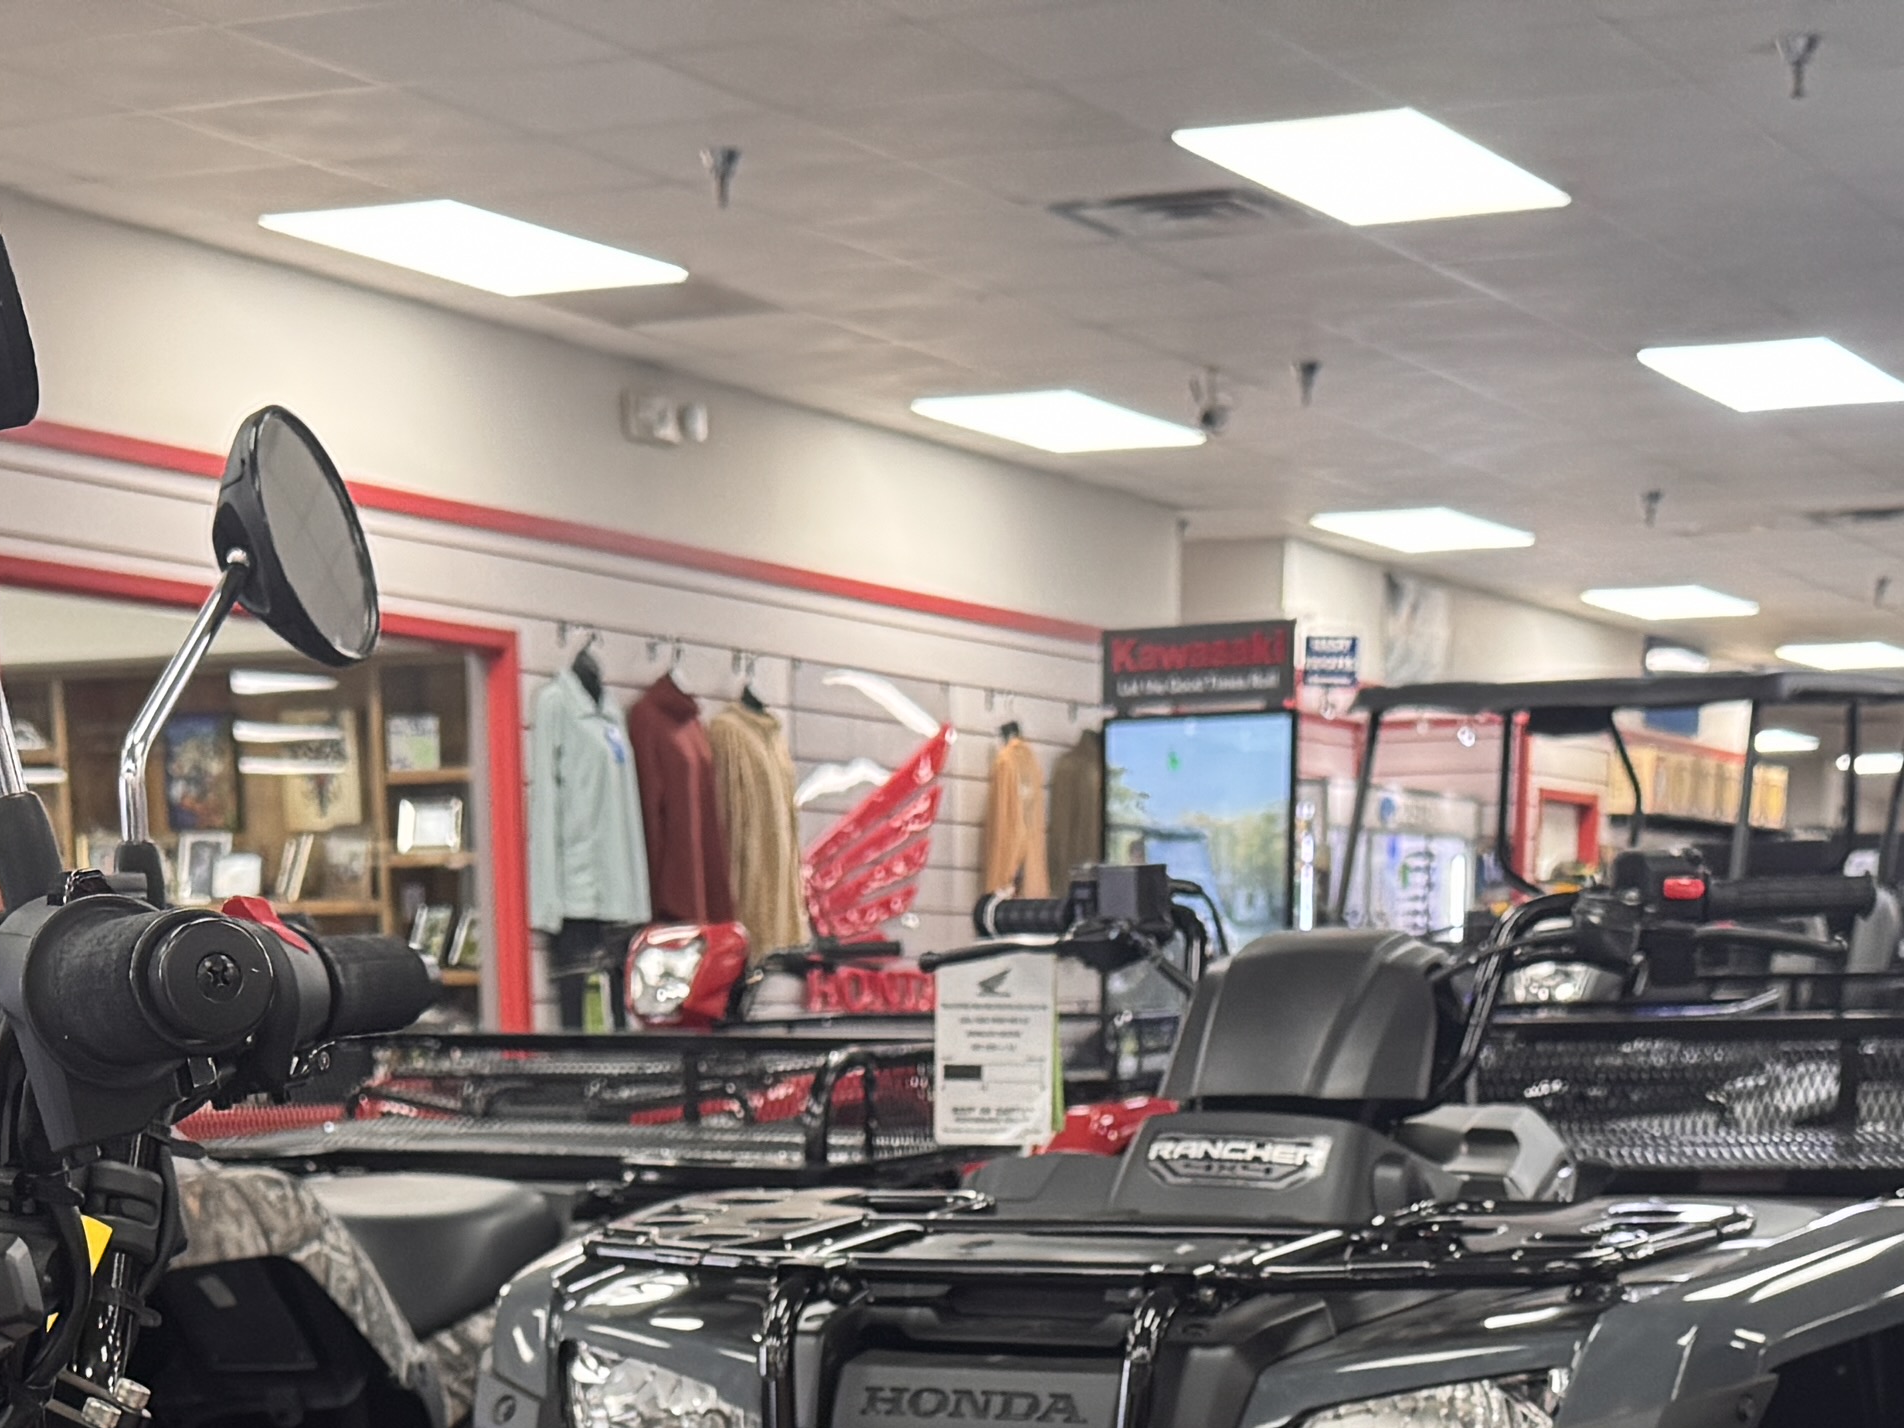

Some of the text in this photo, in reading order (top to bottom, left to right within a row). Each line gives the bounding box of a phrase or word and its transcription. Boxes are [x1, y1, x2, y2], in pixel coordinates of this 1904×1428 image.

[1111, 631, 1286, 673] Kawasaki
[1148, 1137, 1328, 1170] RANCHER
[859, 1386, 1088, 1424] HONDA
